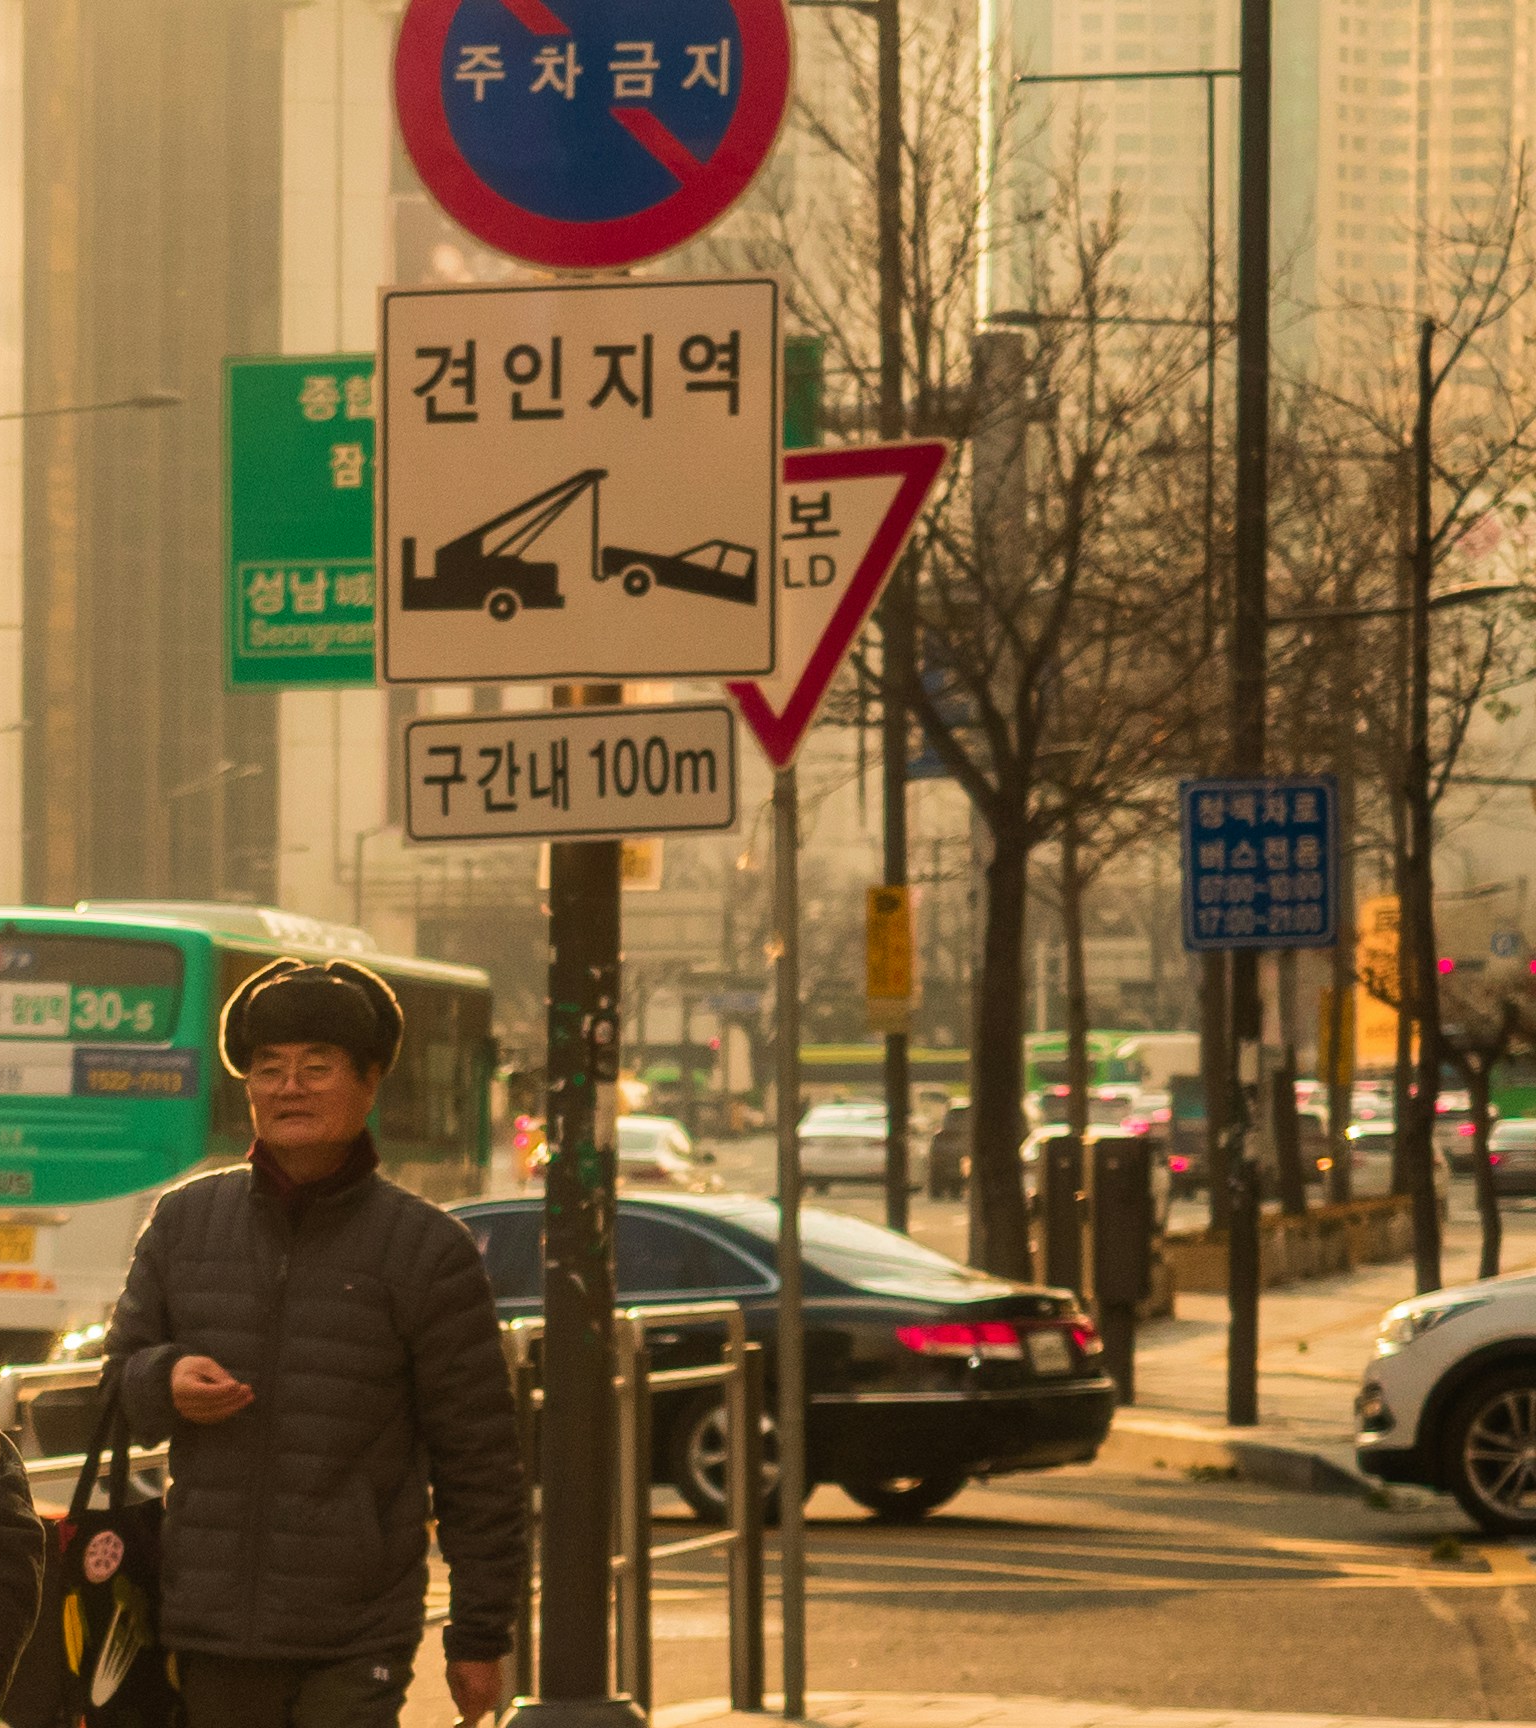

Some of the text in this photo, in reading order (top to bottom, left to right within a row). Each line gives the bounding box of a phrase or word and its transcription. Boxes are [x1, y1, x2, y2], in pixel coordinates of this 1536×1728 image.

[454, 37, 731, 102] 주차금지
[413, 331, 740, 423] 견인지역
[248, 570, 328, 615] 성남
[423, 736, 717, 816] 구간내 100m
